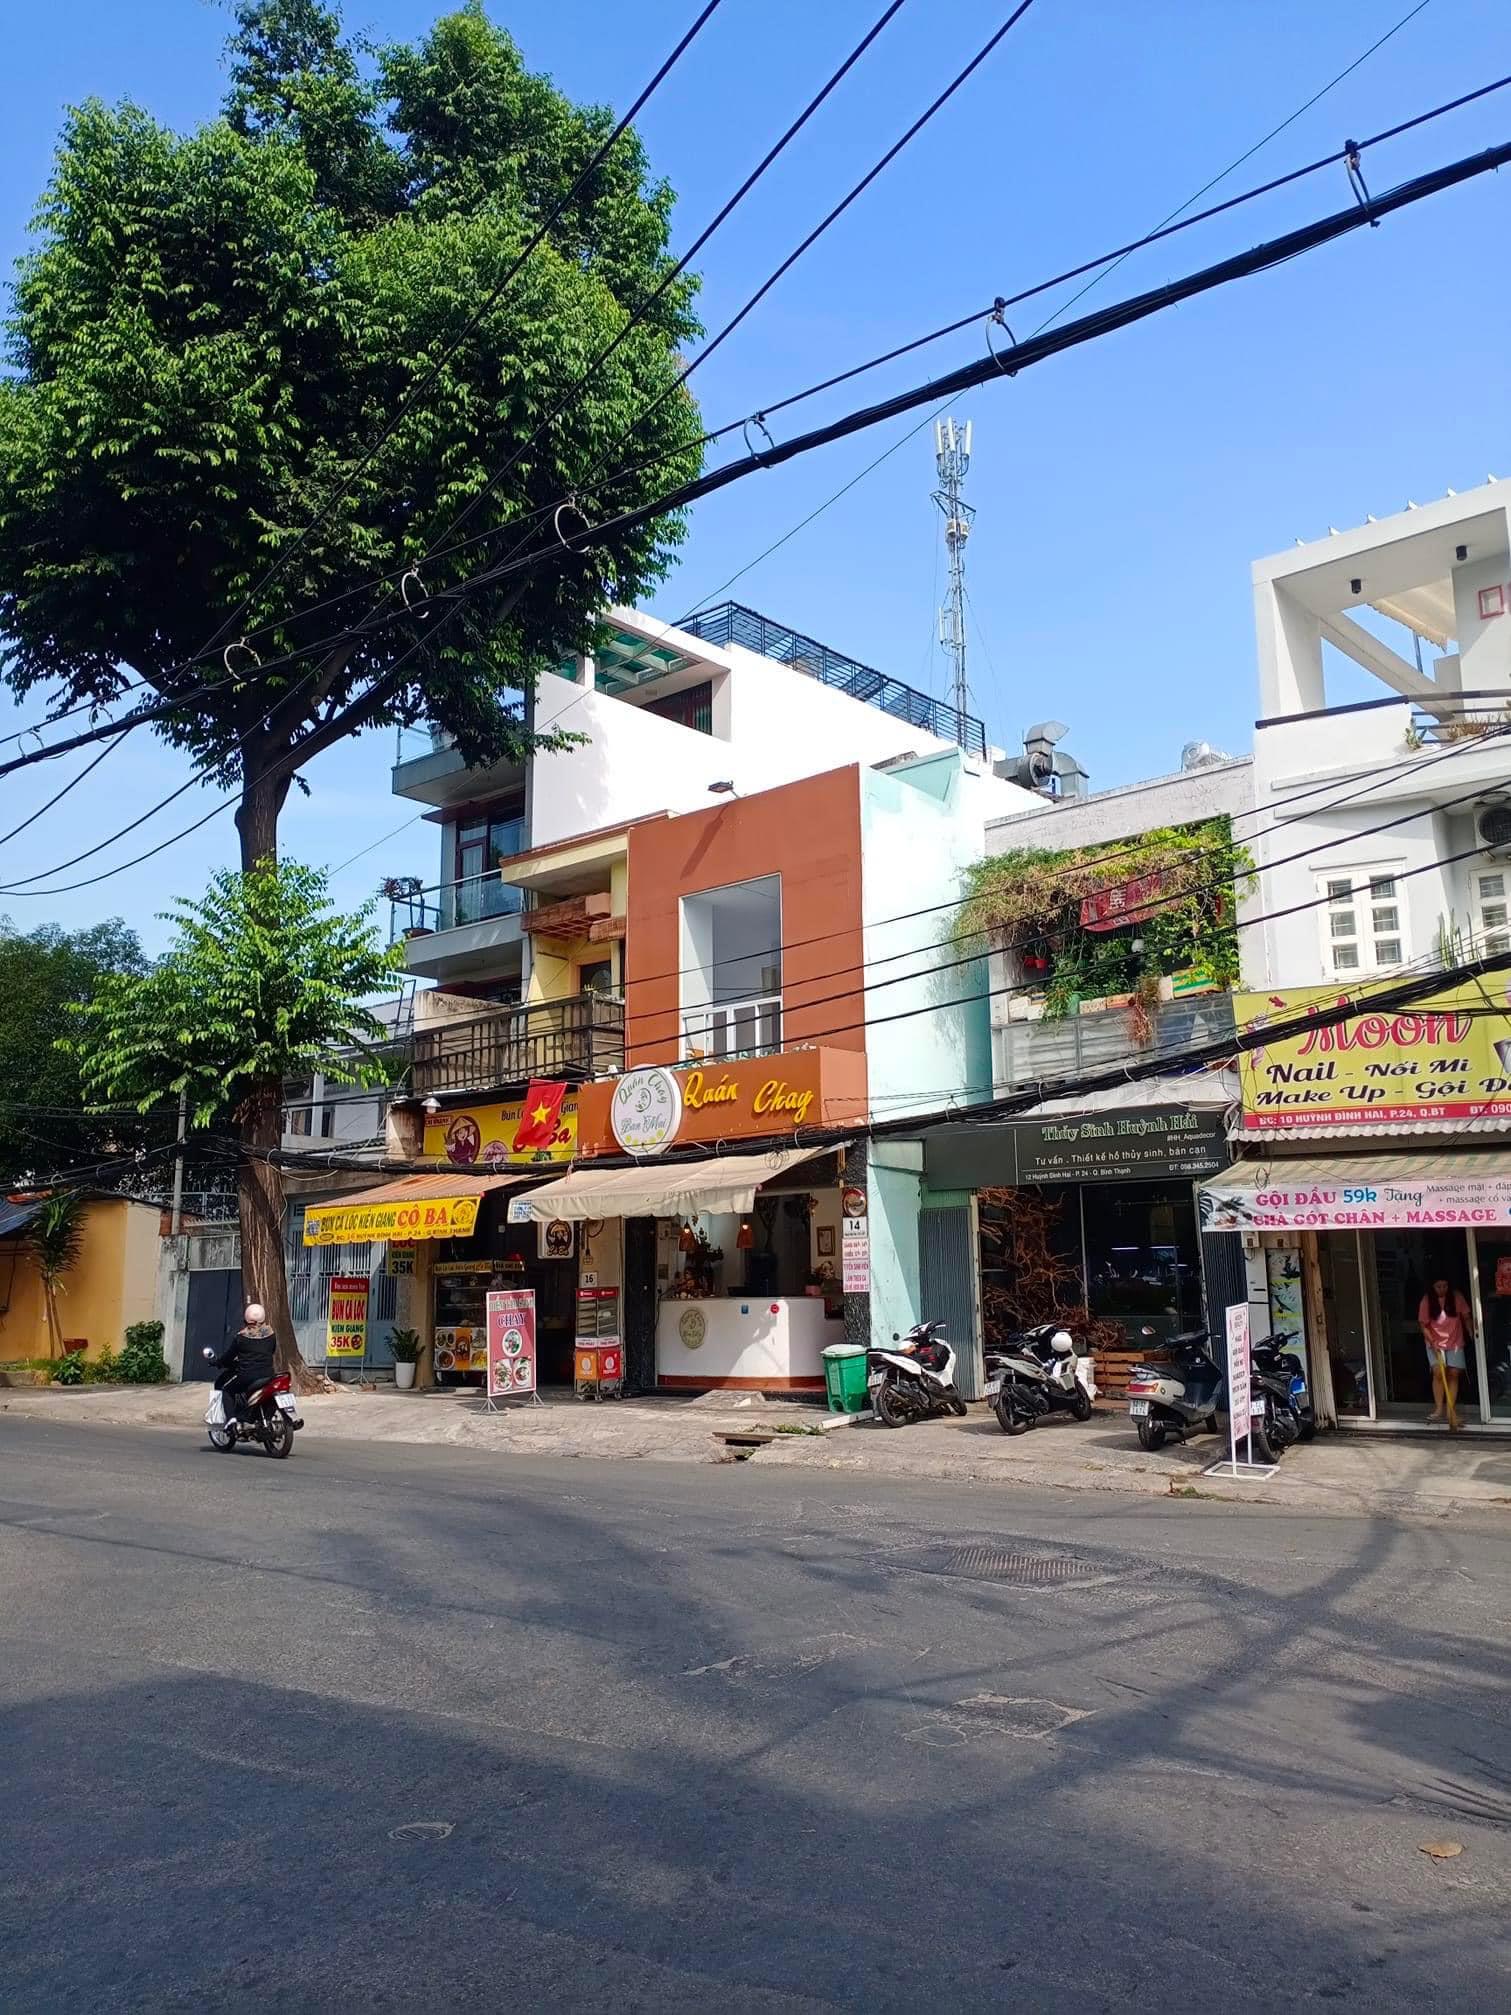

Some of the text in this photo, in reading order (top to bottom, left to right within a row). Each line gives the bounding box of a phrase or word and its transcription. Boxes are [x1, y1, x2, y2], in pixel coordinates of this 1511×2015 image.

[1266, 1061, 1339, 1084] Nail
[1365, 1060, 1422, 1077] Nối
[1429, 1058, 1472, 1073] Mi
[618, 1073, 667, 1105] Quán Chay
[684, 1071, 814, 1123] Quán Chay
[1256, 1089, 1331, 1106] Make
[1340, 1085, 1385, 1103] Up
[1415, 1079, 1470, 1099] Gội
[1280, 1116, 1293, 1124] 10
[1295, 1113, 1331, 1123] HUỲNH
[1335, 1110, 1361, 1121] ĐÌNH
[1420, 1107, 1445, 1117] Q.BT
[1042, 1112, 1198, 1141] Thủy Sinh Huỳnh Hải
[1048, 1155, 1063, 1164] vấn
[1071, 1153, 1093, 1163] Thiết
[1096, 1152, 1106, 1161] kế
[1122, 1149, 1141, 1160] thủy
[1426, 1184, 1465, 1192] Massage
[1256, 1190, 1289, 1209] GỘI
[1295, 1186, 1337, 1205] ĐẦU
[1343, 1187, 1377, 1204] 59k
[1446, 1196, 1485, 1204] massage
[376, 1212, 397, 1228] GIANG
[397, 1204, 419, 1227] CÔ
[424, 1207, 448, 1226] BA
[1253, 1211, 1289, 1226] CHÀ
[1293, 1211, 1328, 1224] GÓT
[1334, 1209, 1385, 1224] CHÂN
[1406, 1209, 1497, 1224] MASSAGE
[849, 1221, 860, 1230] 14
[392, 1261, 413, 1274] 35K
[585, 1274, 594, 1283] 16
[497, 1312, 525, 1328] CHAY
[331, 1336, 350, 1347] 35K
